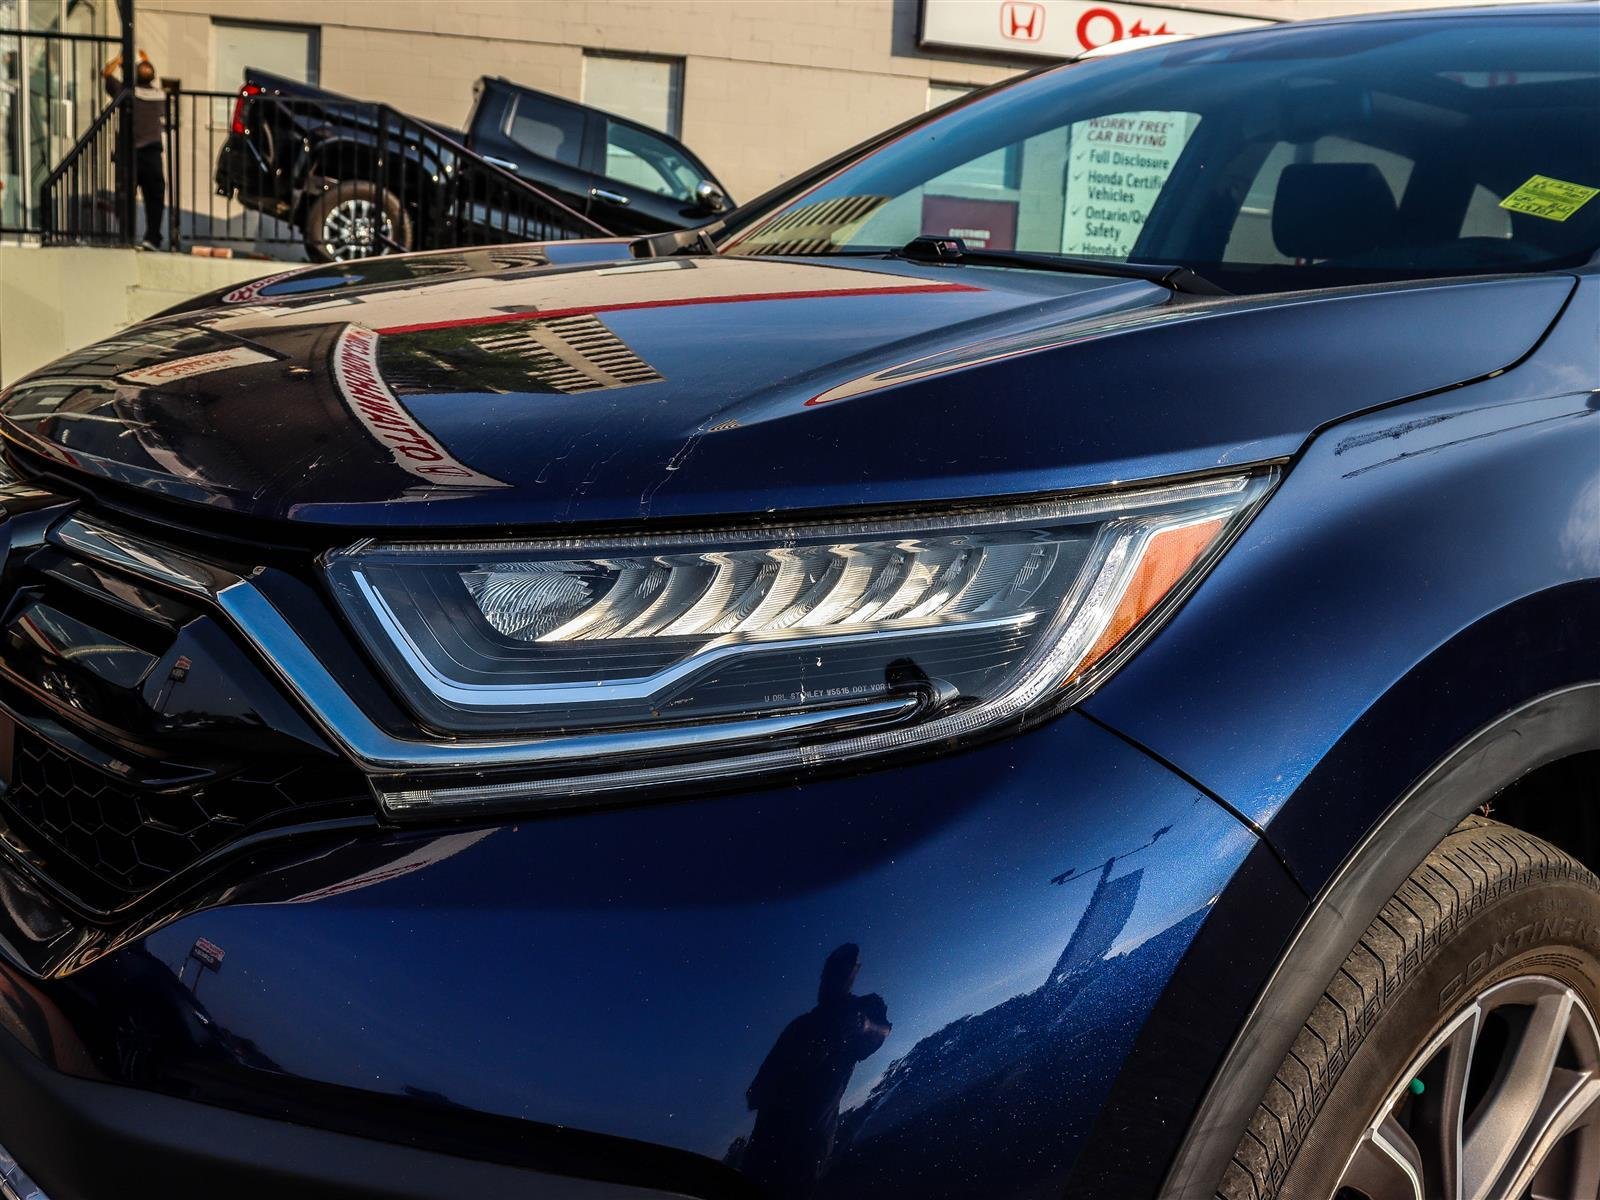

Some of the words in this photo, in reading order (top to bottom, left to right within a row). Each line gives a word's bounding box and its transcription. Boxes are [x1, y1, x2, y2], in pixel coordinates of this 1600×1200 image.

[1088, 117, 1135, 130] WORRY
[1087, 130, 1112, 142] CAR
[1115, 132, 1167, 147] BUYING
[1089, 150, 1110, 163] Full
[1113, 152, 1170, 170] Disclosure
[1088, 171, 1123, 186] Honda
[1088, 187, 1135, 203] Vehicles
[1085, 223, 1121, 241] Safety
[1082, 242, 1117, 257] Honda
[1438, 916, 1600, 1012] CONTINEN
